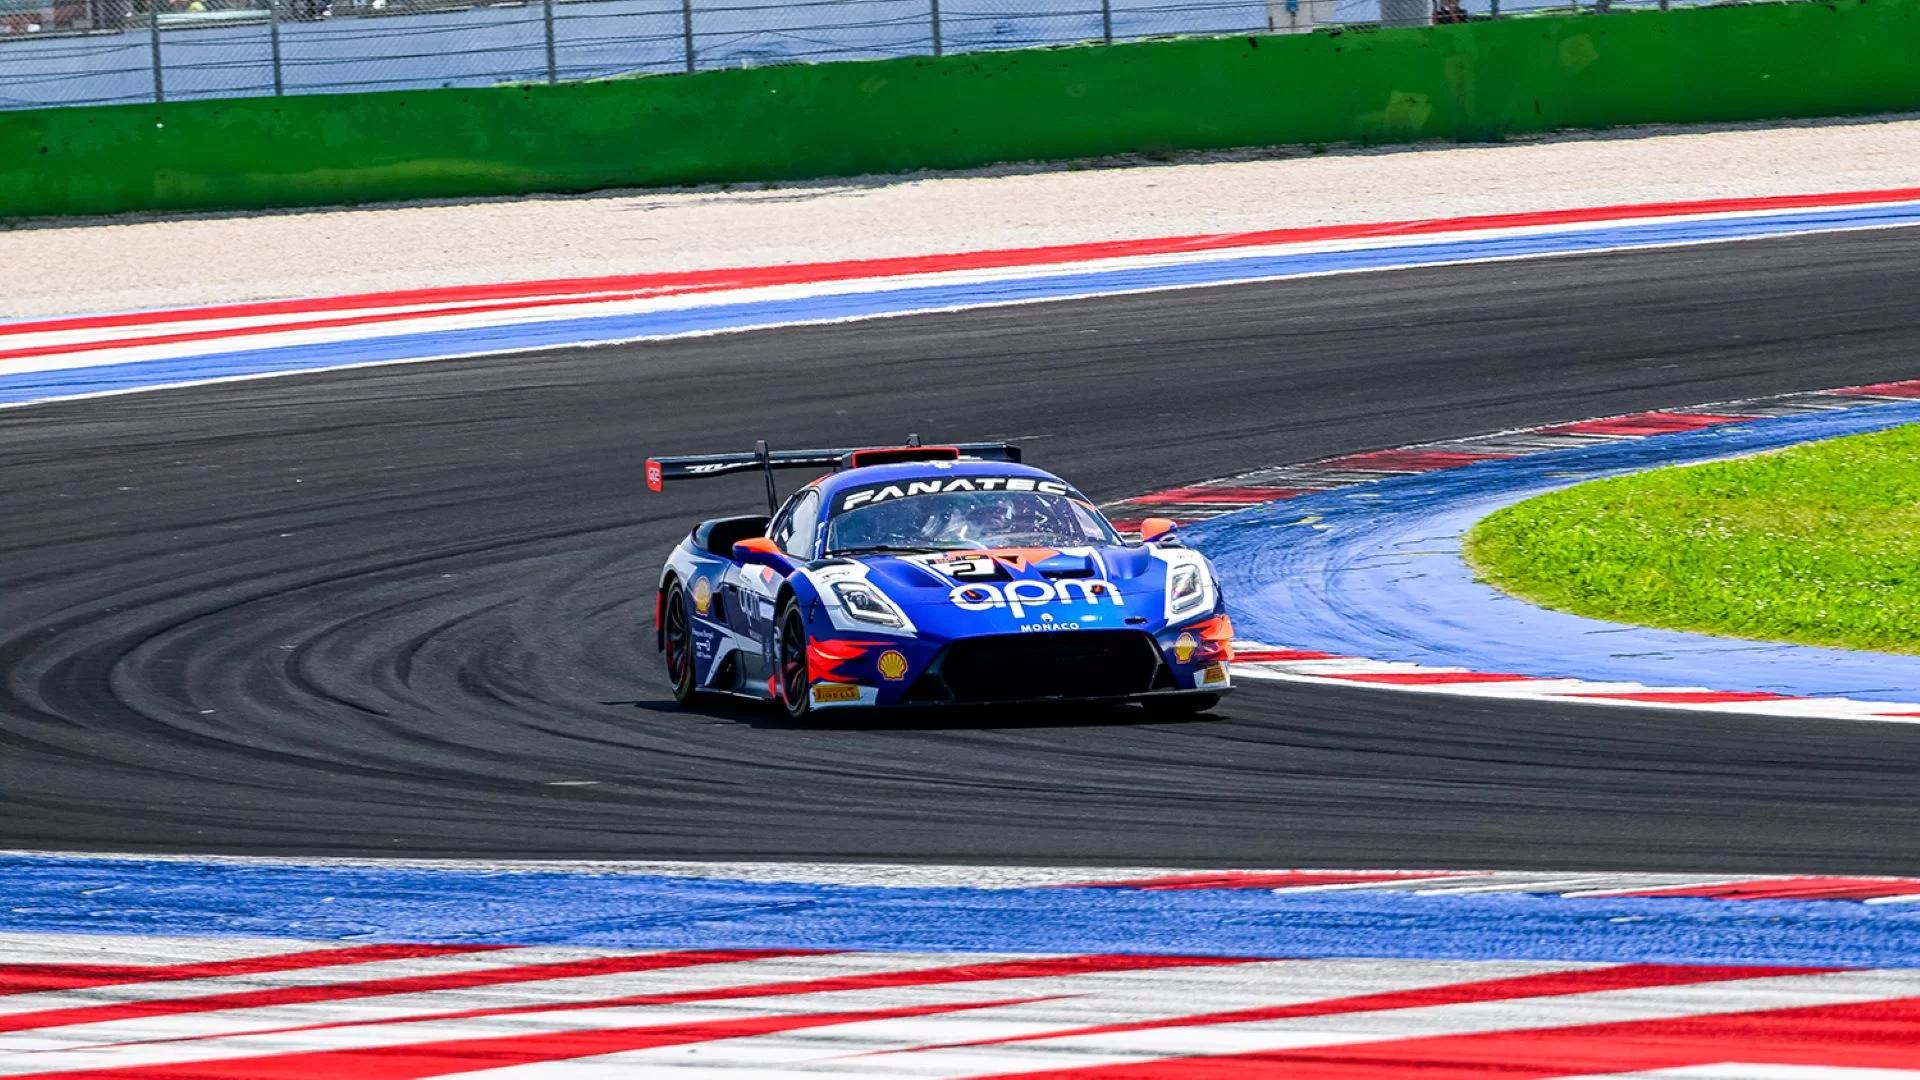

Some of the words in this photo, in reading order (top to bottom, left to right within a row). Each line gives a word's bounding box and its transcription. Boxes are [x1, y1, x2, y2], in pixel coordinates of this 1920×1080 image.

[843, 478, 1067, 510] FANATEC
[949, 578, 1124, 619] apm
[1021, 622, 1080, 632] MONACO
